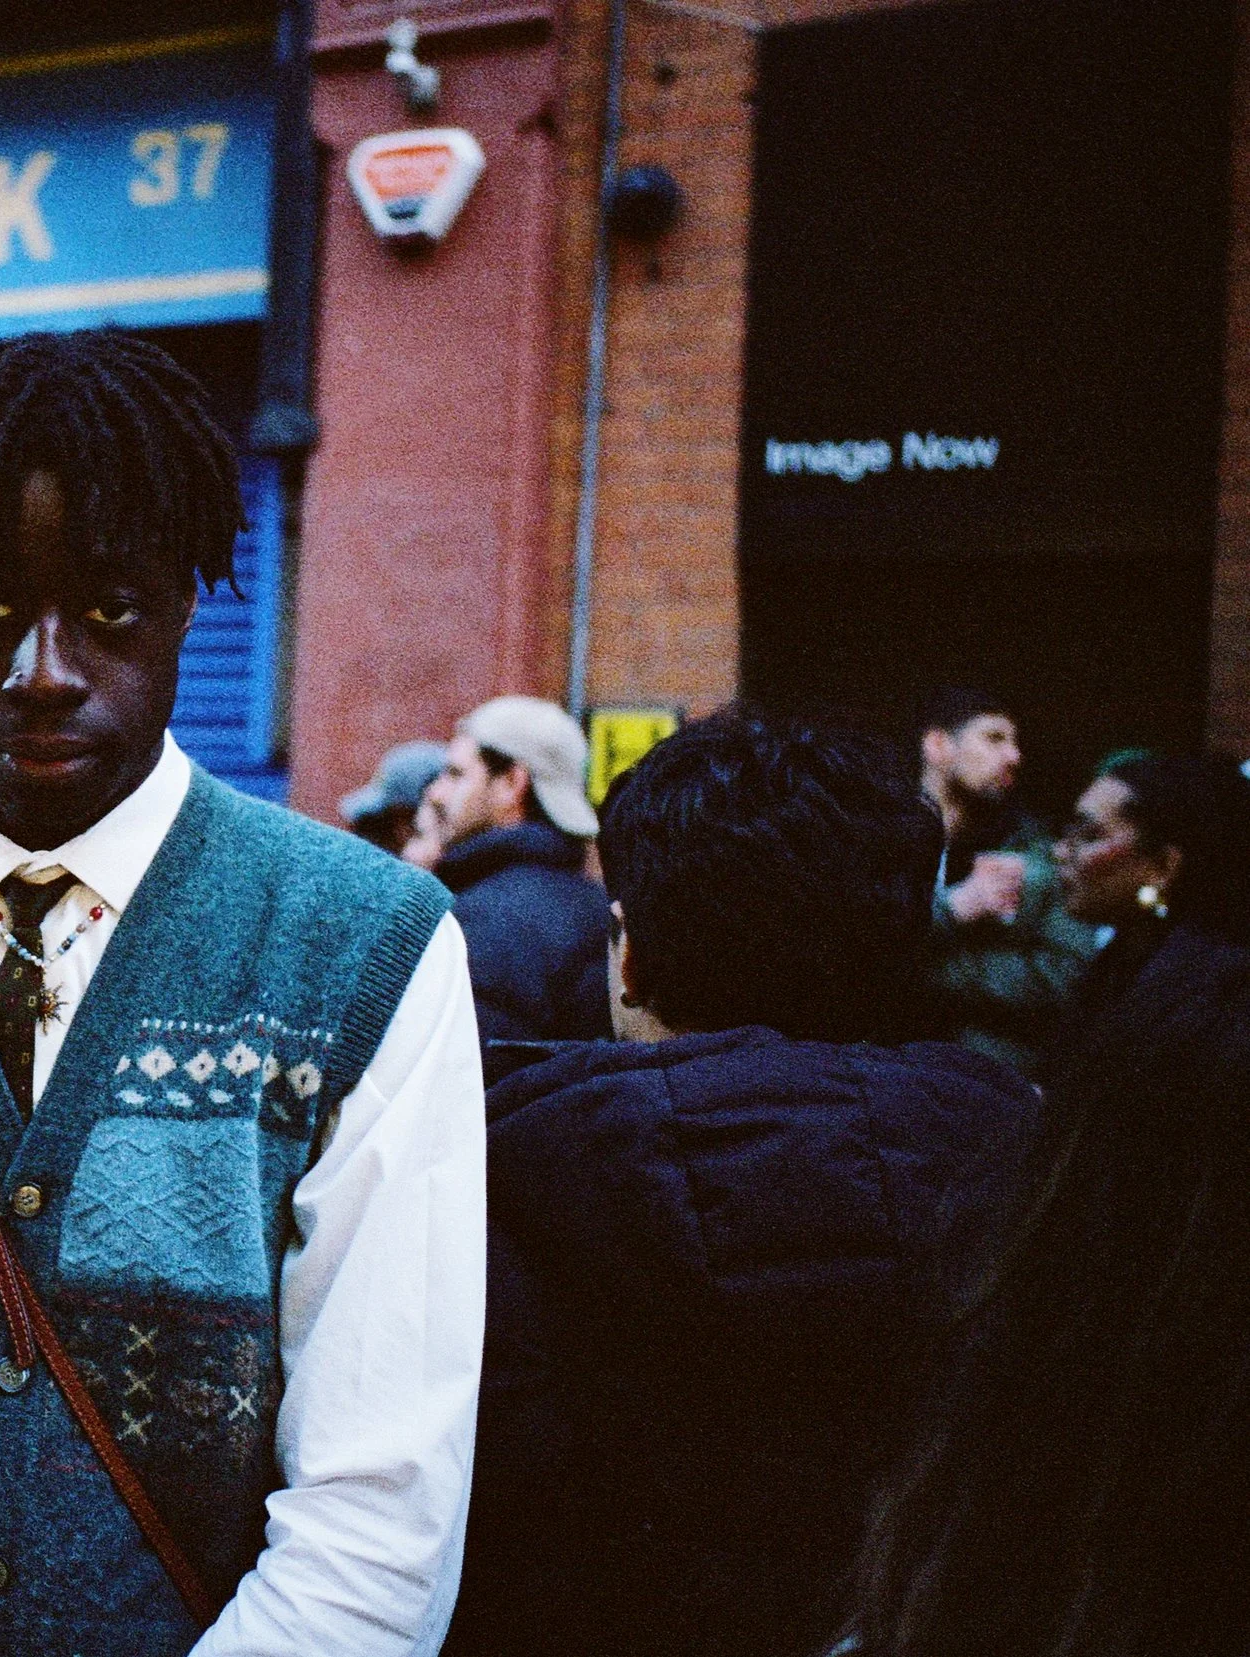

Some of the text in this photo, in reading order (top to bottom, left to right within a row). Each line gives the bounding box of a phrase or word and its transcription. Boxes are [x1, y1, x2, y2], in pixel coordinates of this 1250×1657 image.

[129, 123, 230, 206] 37
[765, 430, 999, 483] Image Now
